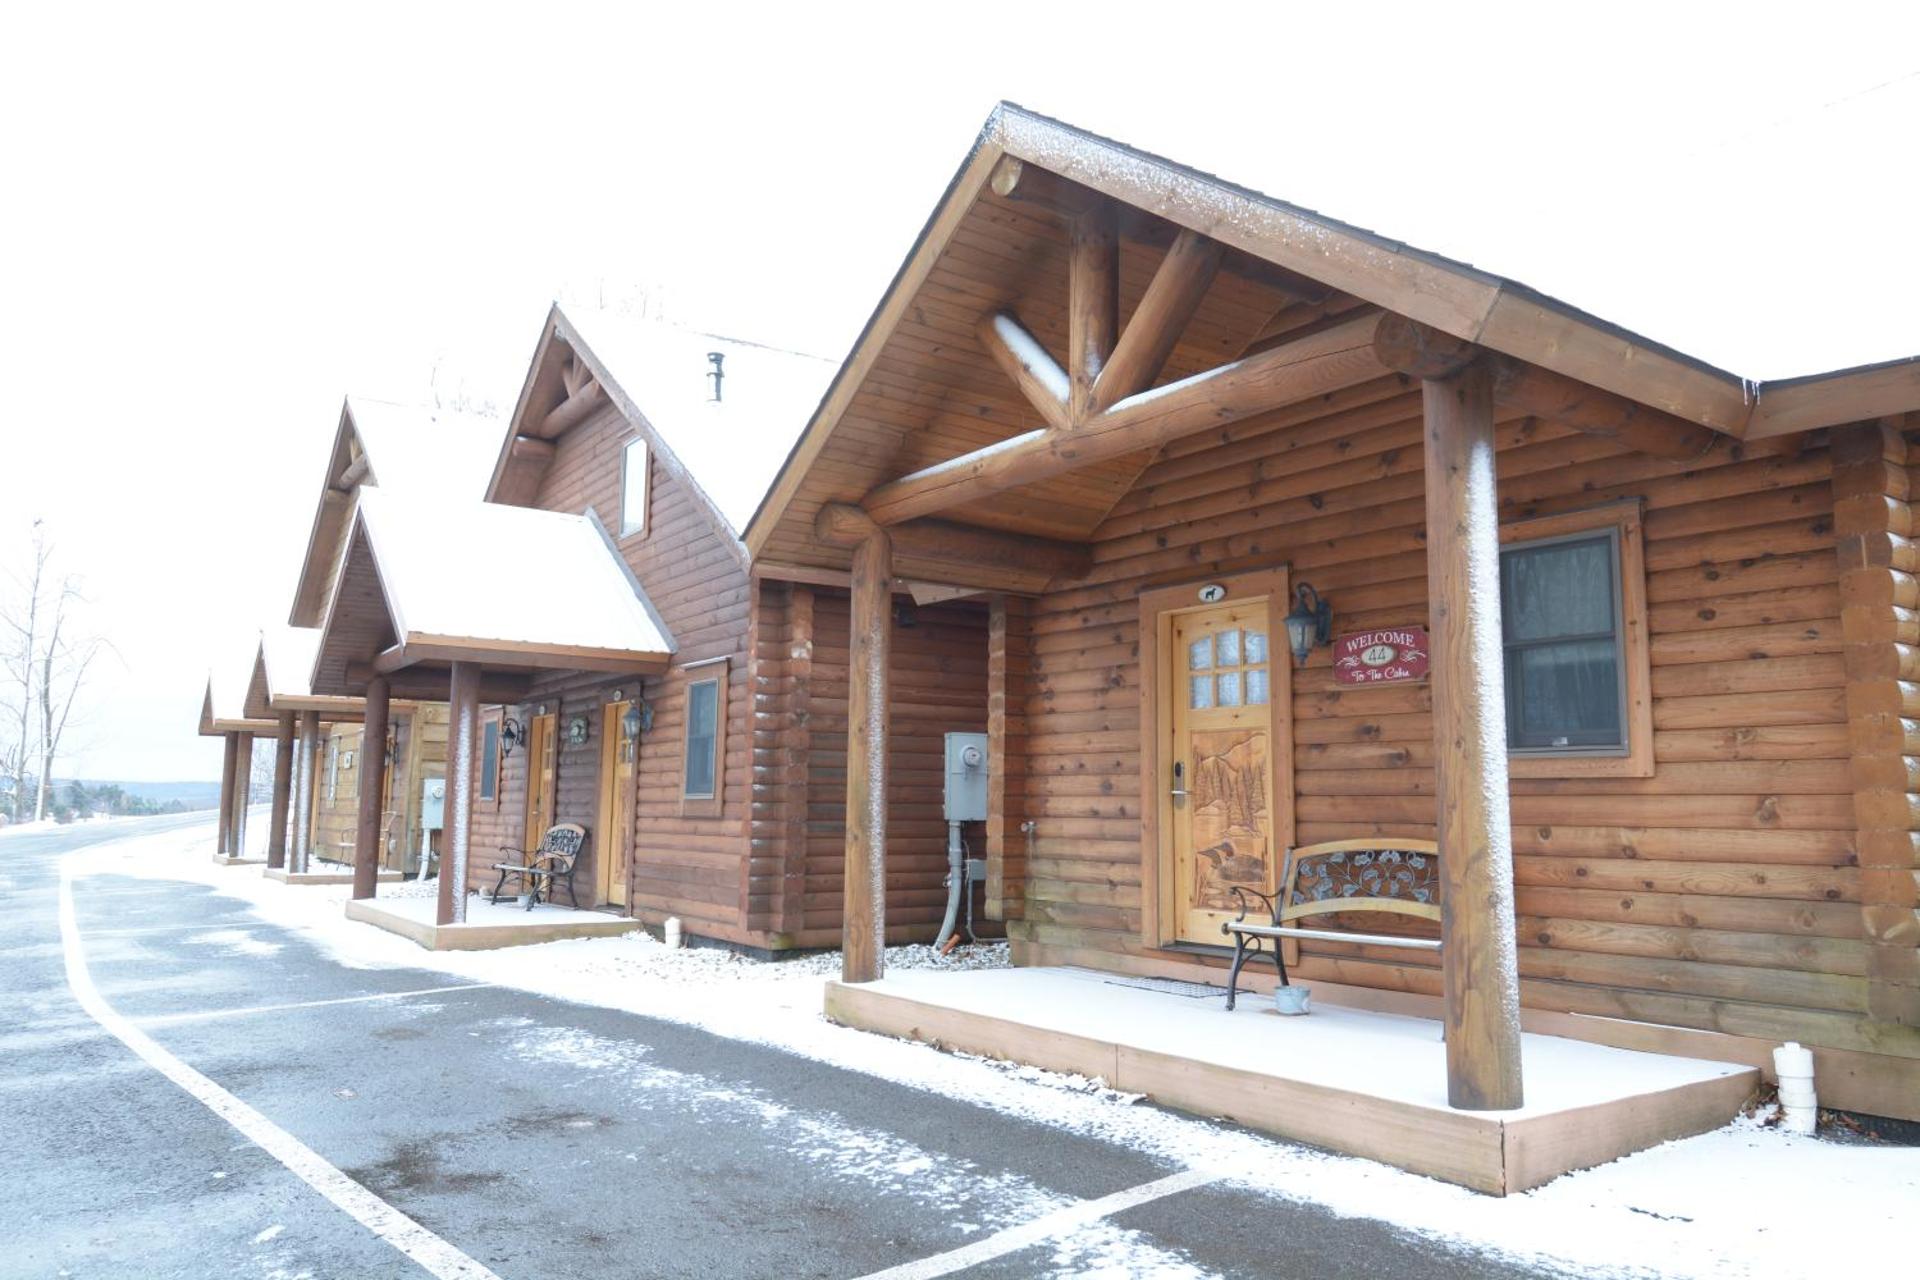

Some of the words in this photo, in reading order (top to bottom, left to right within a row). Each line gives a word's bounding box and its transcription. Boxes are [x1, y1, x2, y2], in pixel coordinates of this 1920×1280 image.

[1346, 631, 1415, 652] WELCOME
[1368, 647, 1386, 661] 44
[1351, 670, 1364, 682] To
[1366, 669, 1382, 681] The
